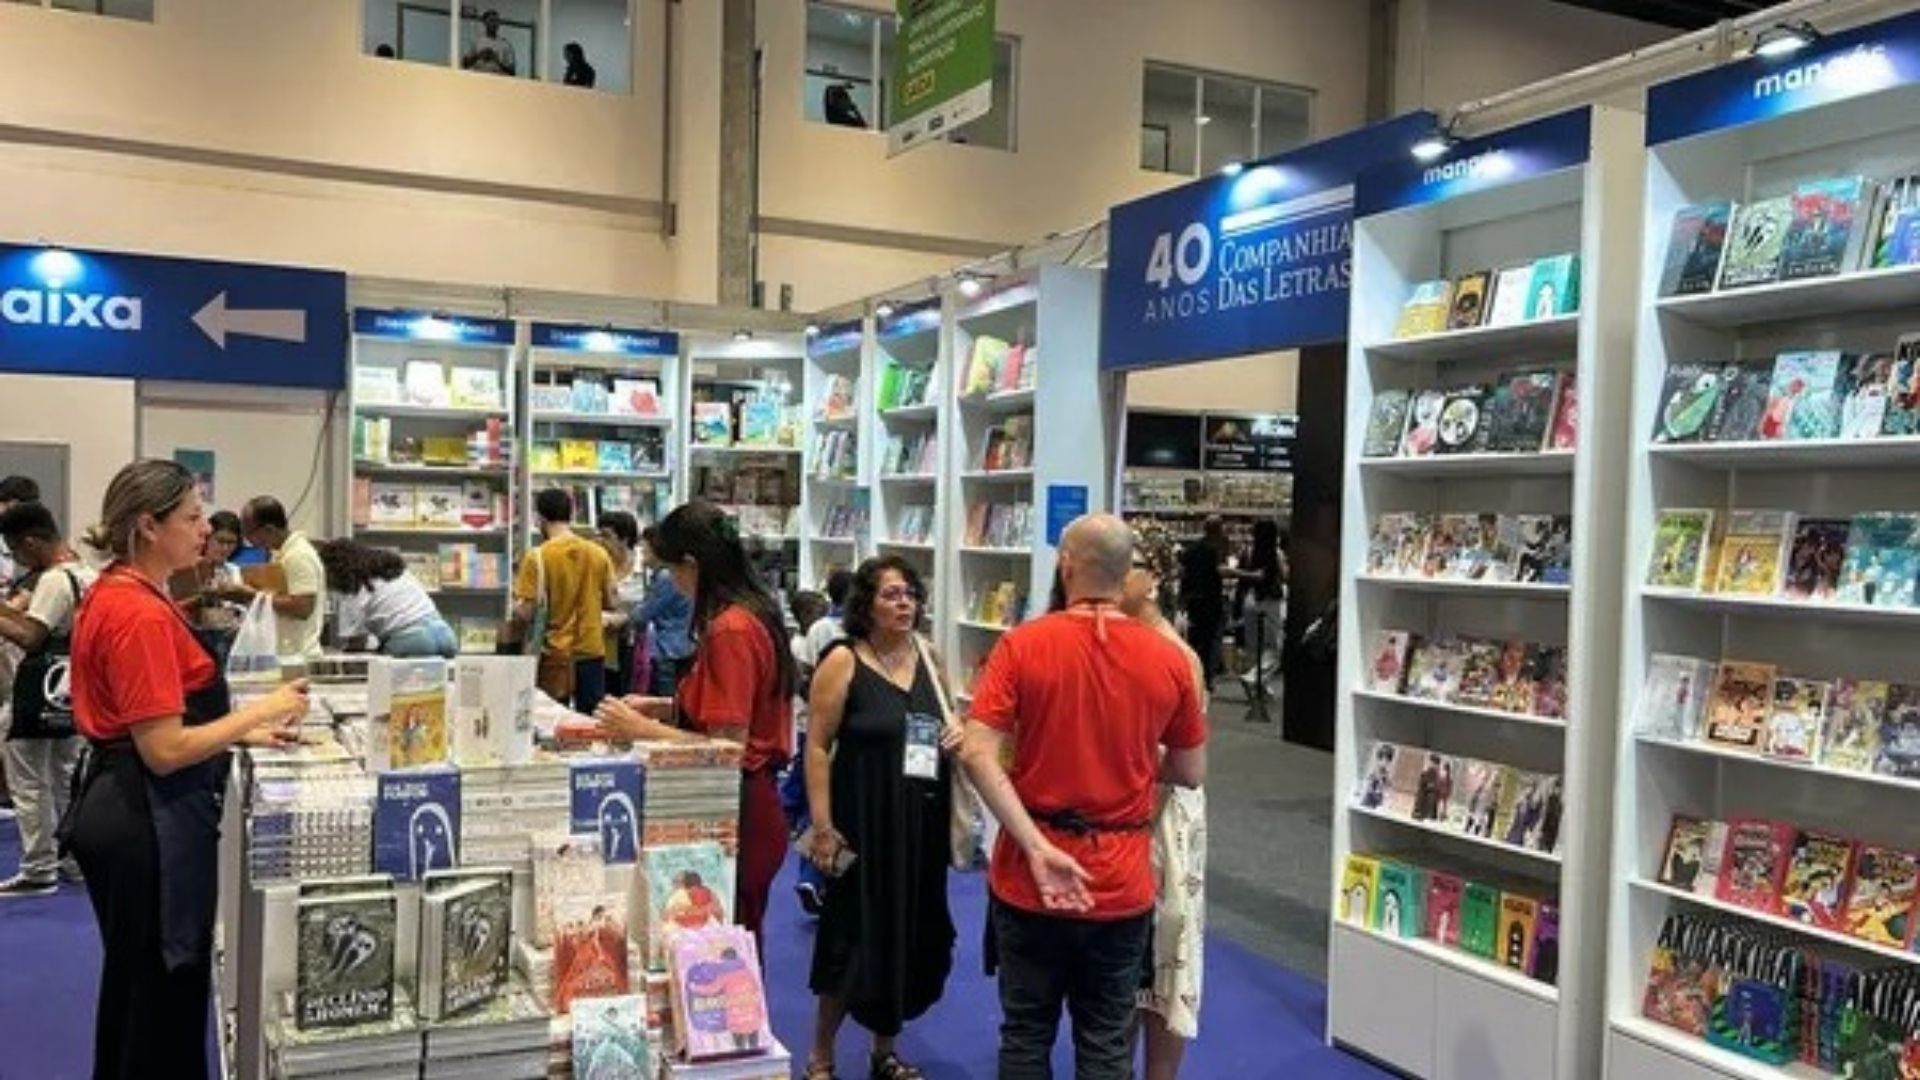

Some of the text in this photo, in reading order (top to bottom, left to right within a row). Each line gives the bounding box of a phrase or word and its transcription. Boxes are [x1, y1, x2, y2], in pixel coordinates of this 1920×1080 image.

[1145, 222, 1212, 289] 40
[0, 282, 141, 330] aixa
[1145, 286, 1211, 322] ANOS
